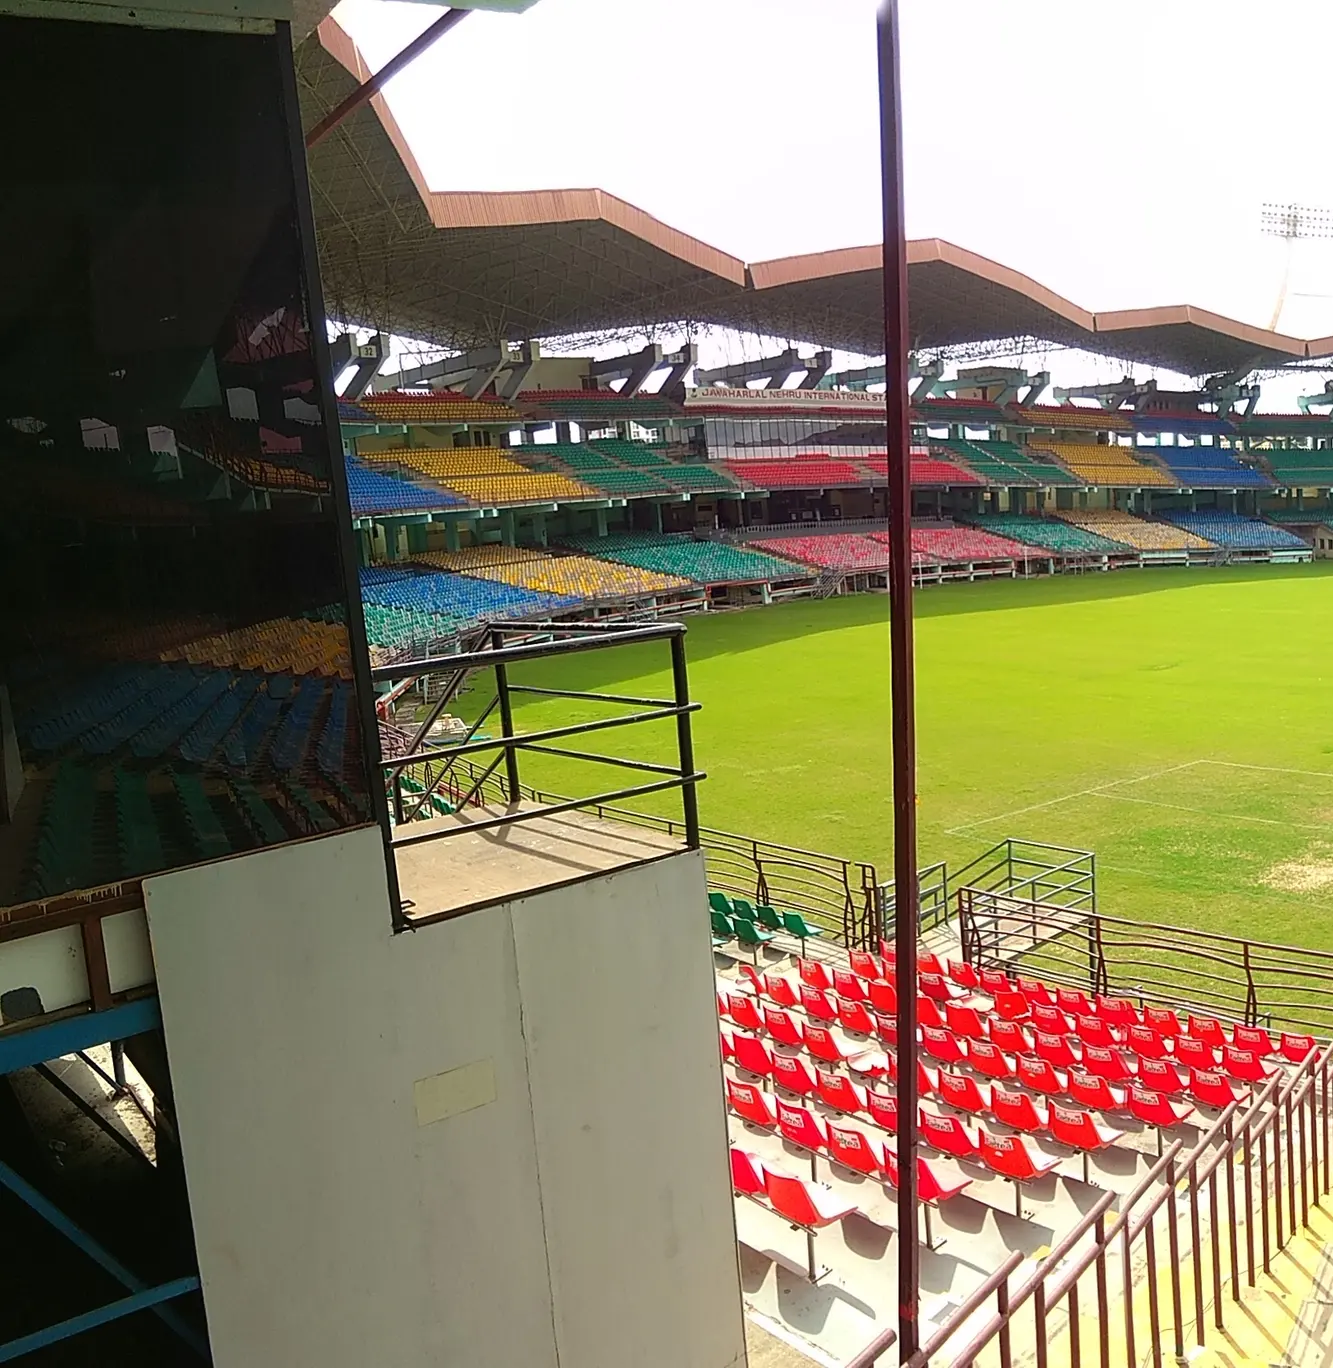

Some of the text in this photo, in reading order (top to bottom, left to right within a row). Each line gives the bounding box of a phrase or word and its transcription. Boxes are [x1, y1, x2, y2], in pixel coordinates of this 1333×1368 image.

[364, 347, 373, 356] 32
[701, 388, 766, 399] JAWAHARLAL
[769, 390, 801, 399] NEHRU
[804, 391, 870, 401] INTERNATIONAL
